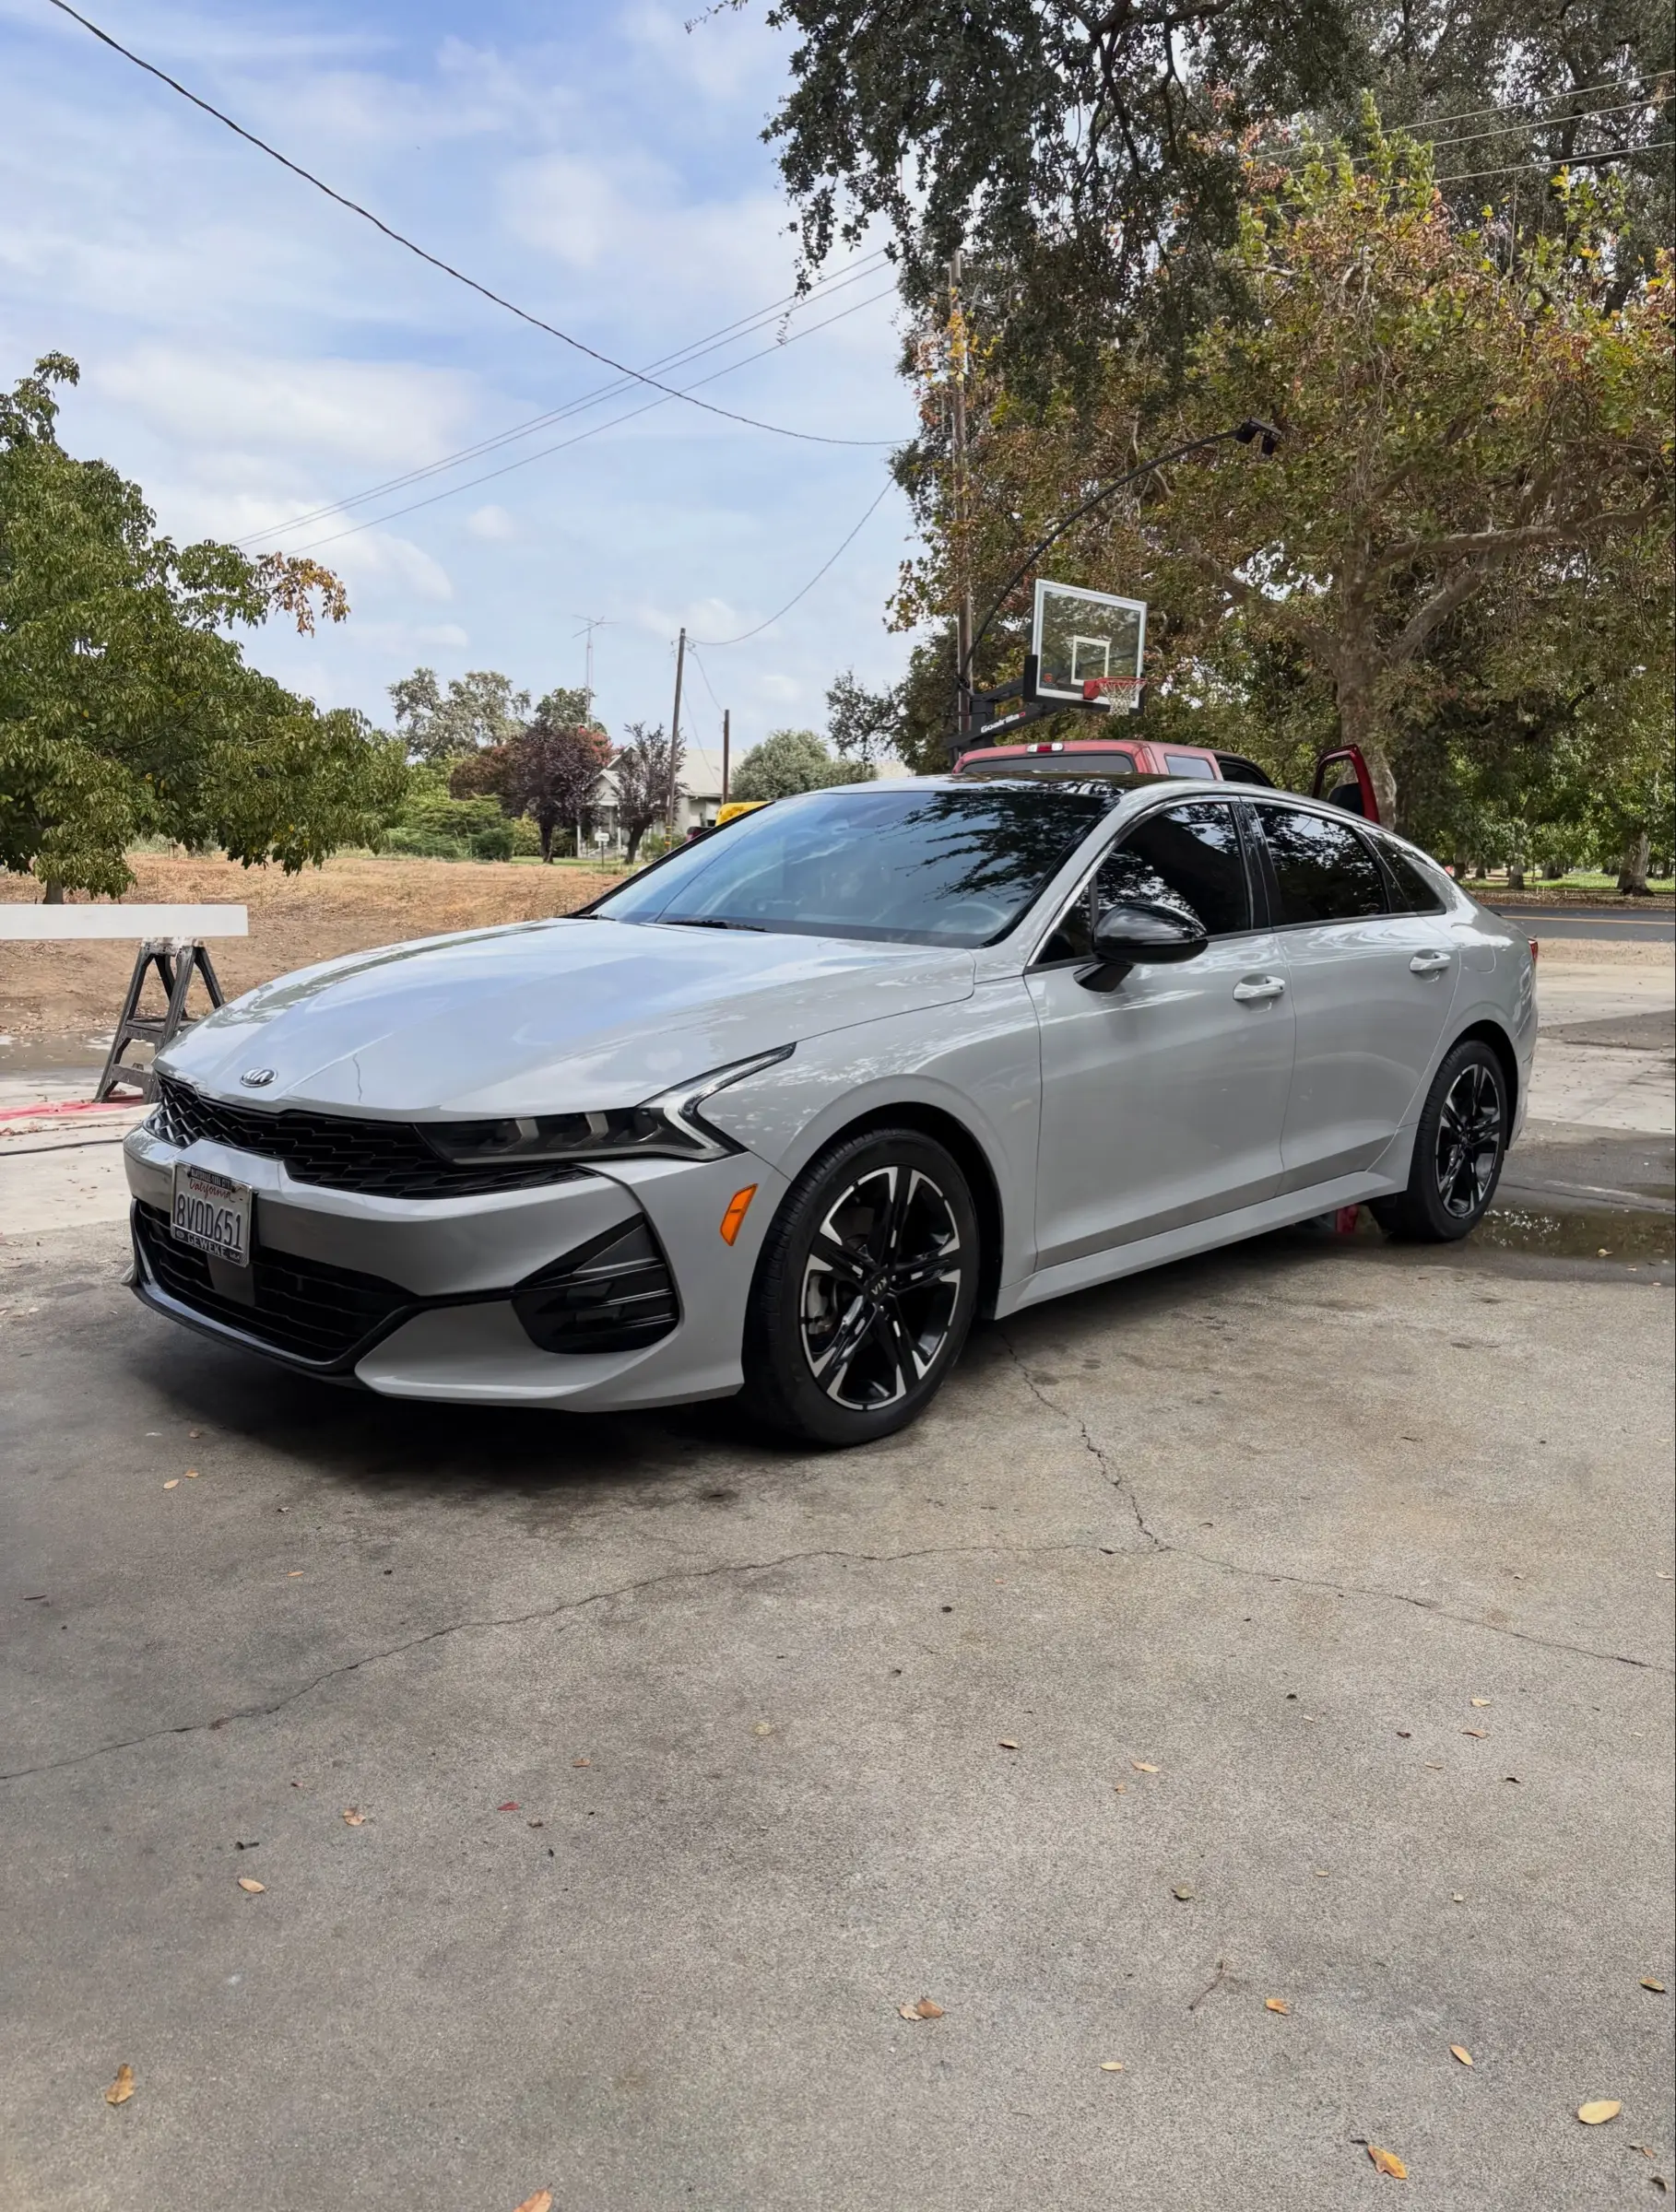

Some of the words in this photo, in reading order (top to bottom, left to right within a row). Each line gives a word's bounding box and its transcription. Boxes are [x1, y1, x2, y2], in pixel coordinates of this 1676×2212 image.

[243, 1068, 270, 1082] KIA
[190, 1179, 235, 1203] California
[187, 1233, 227, 1258] GEWEKE
[871, 1277, 887, 1295] KIA
